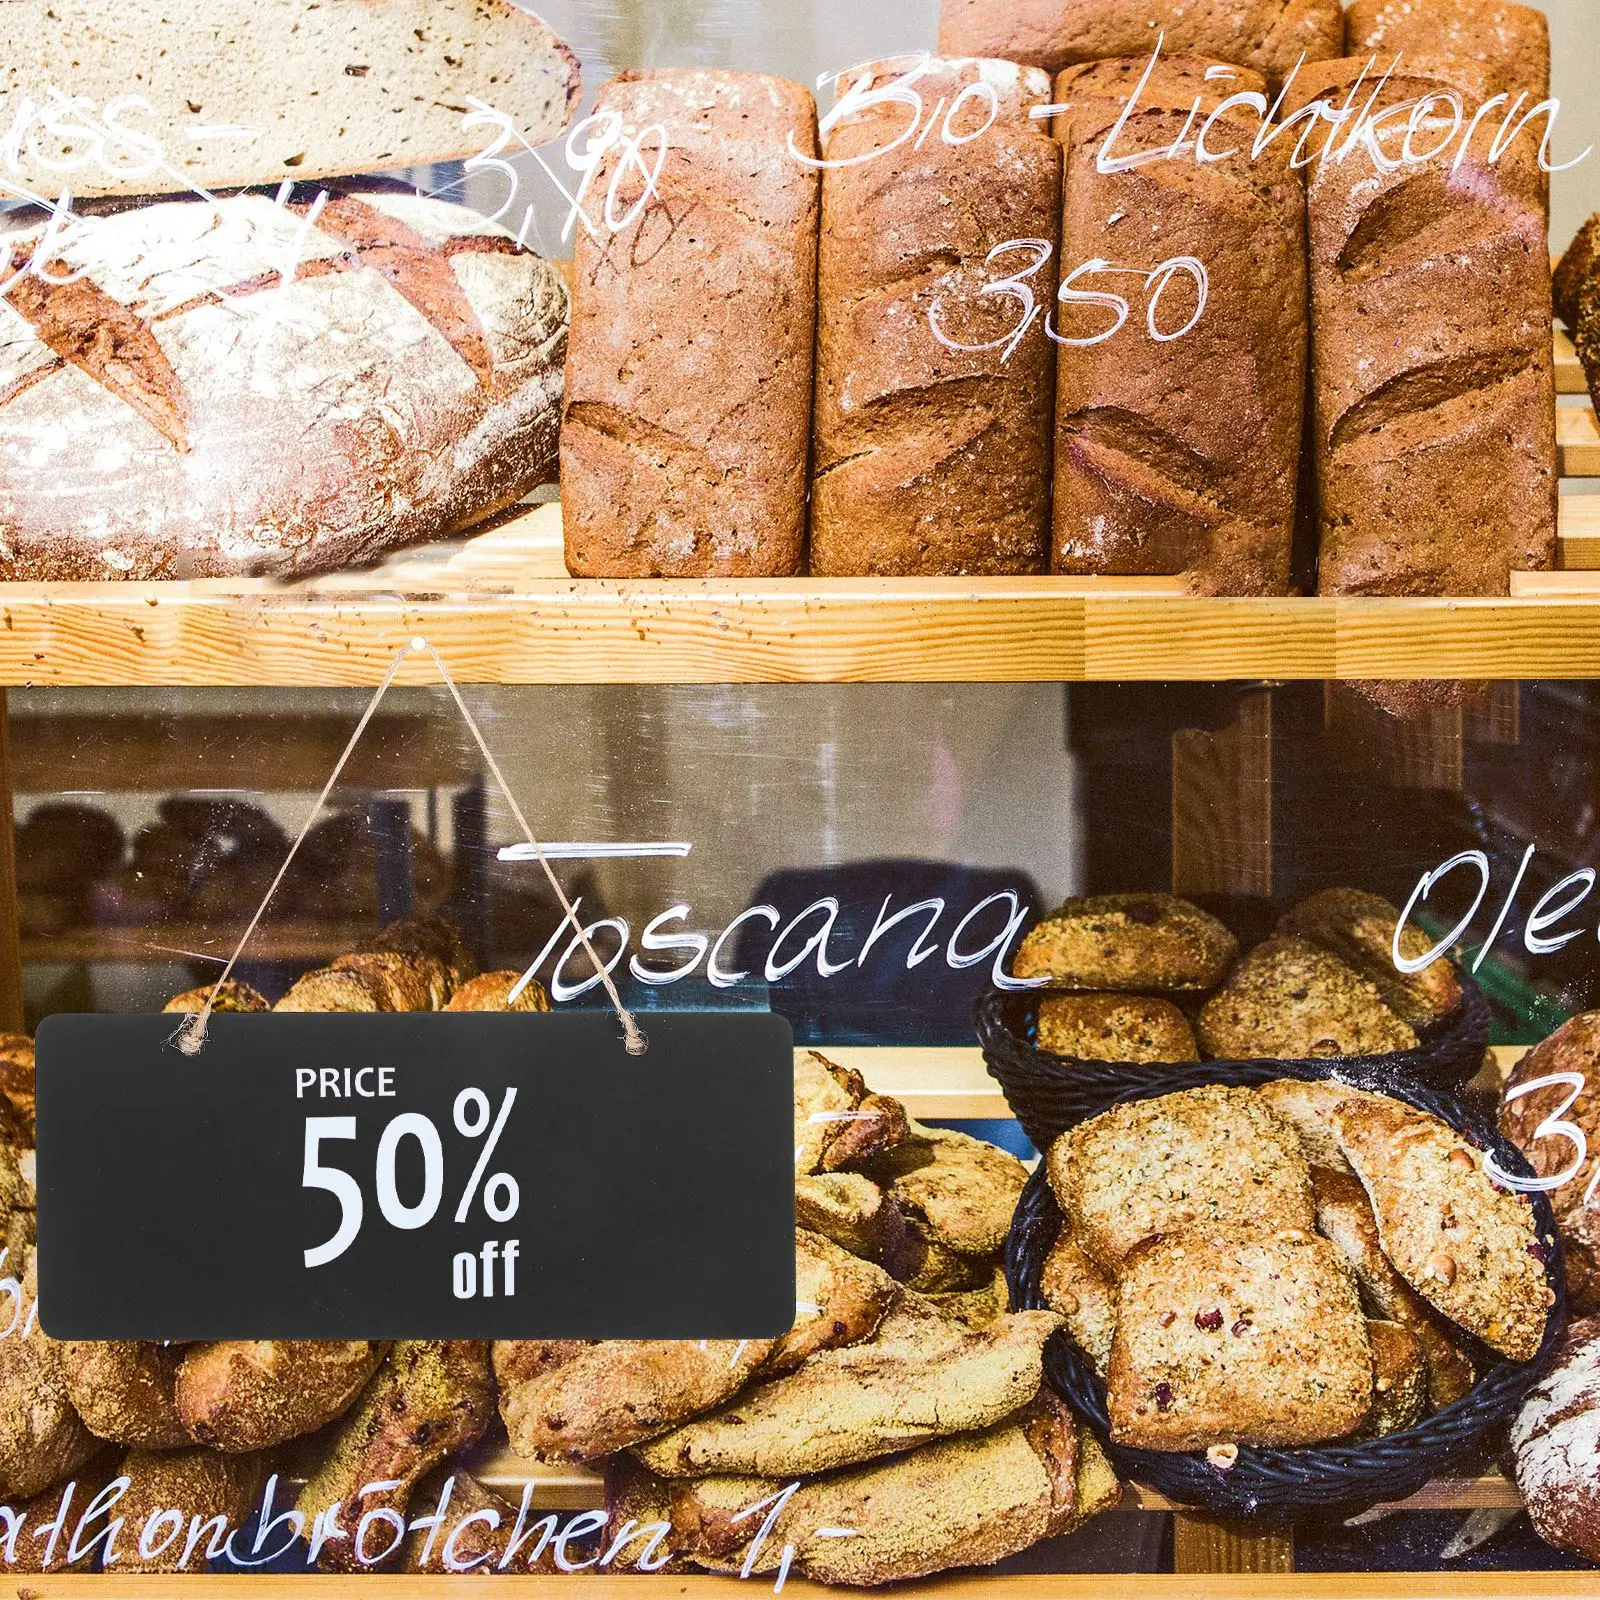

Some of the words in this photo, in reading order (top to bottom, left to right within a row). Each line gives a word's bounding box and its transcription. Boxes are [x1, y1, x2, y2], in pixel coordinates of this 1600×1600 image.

[928, 238, 1209, 365] 3,50
[497, 842, 1053, 1005] Toscana
[1392, 843, 1600, 975] Ole
[295, 1067, 396, 1098] PRICE
[302, 1086, 520, 1269] 50%
[452, 1239, 520, 1299] off
